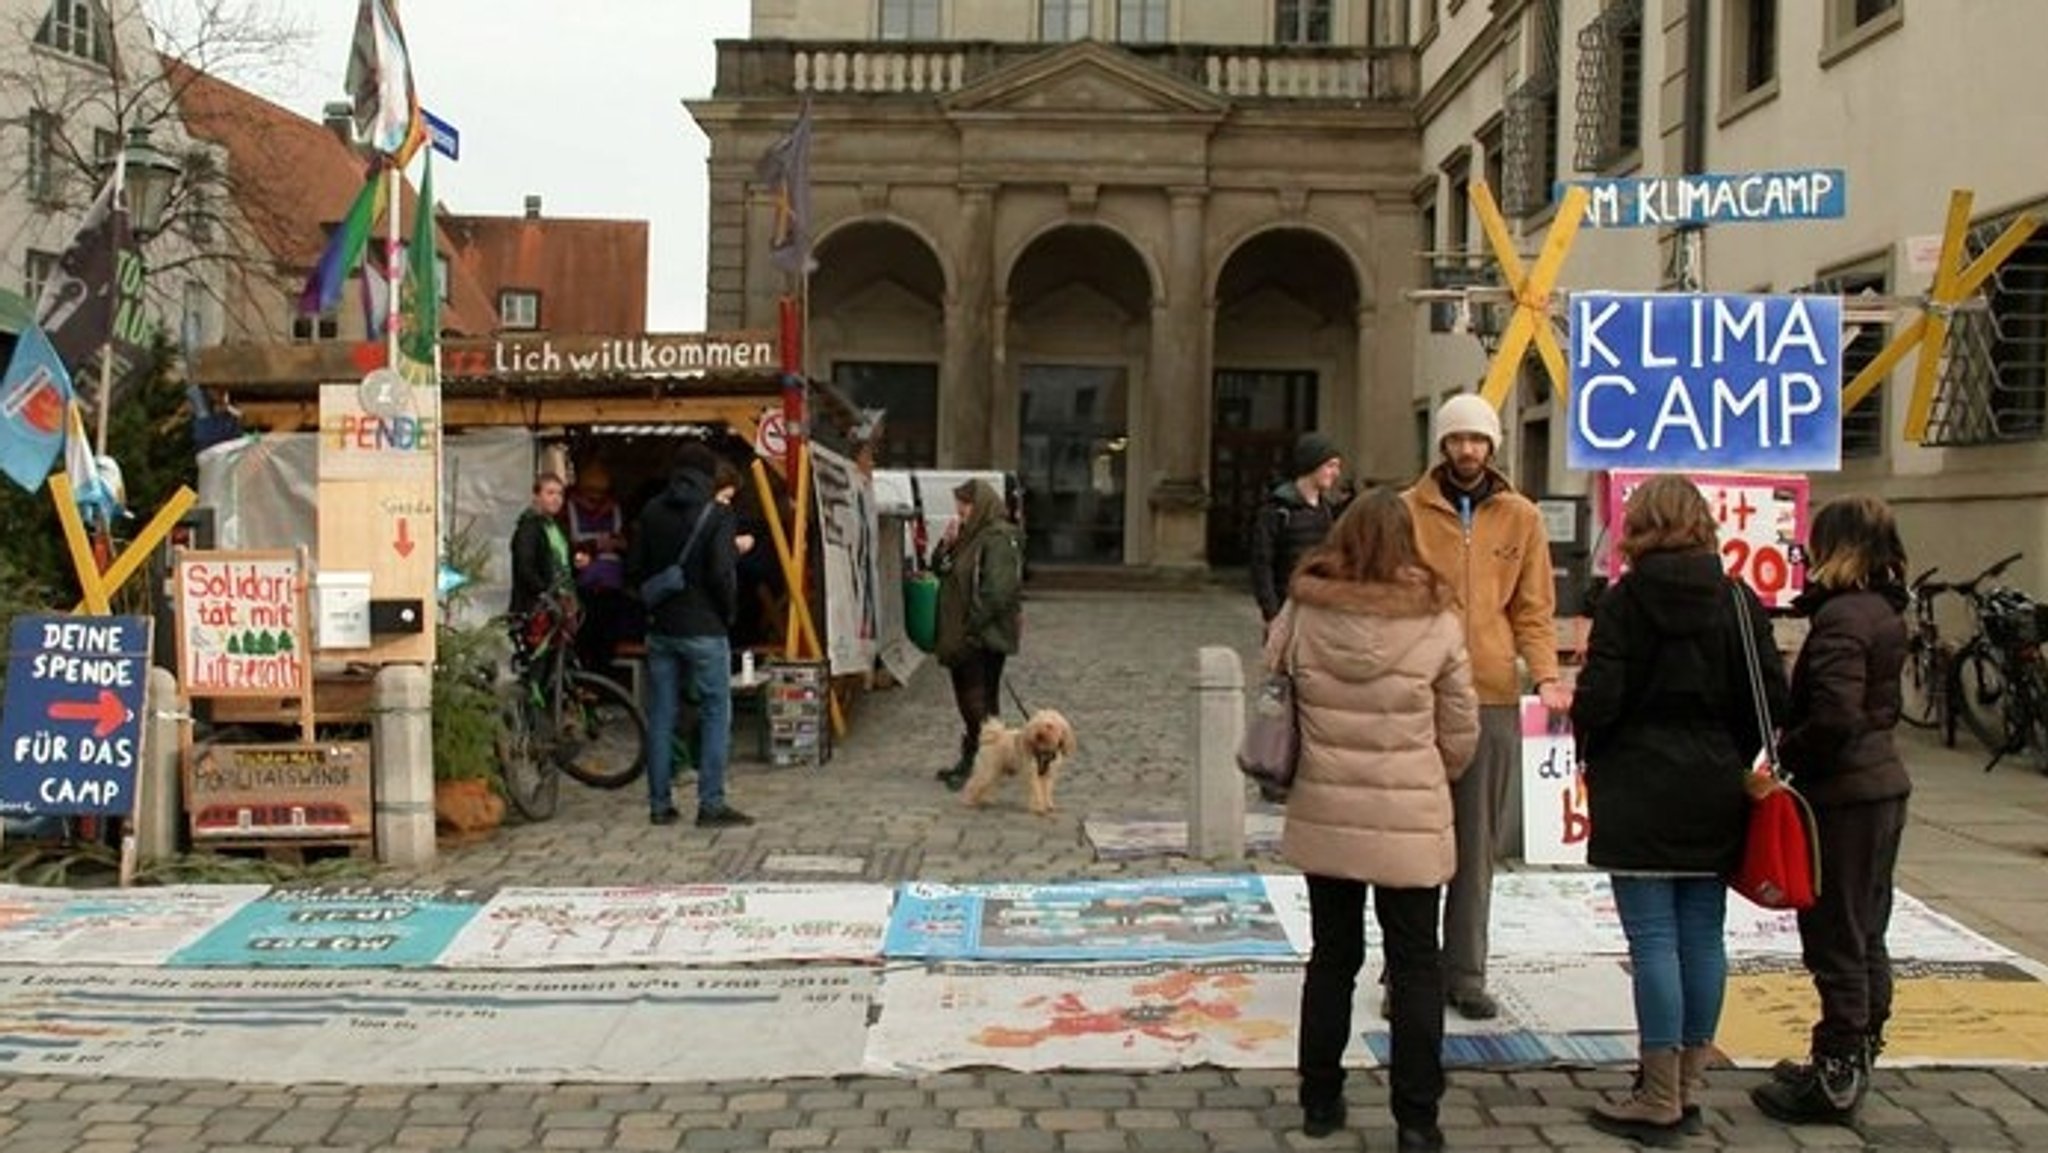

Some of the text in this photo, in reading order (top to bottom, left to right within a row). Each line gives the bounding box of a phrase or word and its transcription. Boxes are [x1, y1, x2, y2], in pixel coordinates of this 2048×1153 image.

[1638, 173, 1833, 224] KLIMACAMP
[1579, 299, 1827, 368] KLIMA
[569, 339, 771, 371] willkommen
[1579, 373, 1822, 452] CAMP
[250, 603, 293, 628] mit
[43, 623, 123, 653] DEINE
[32, 654, 133, 686] SPENDE
[14, 731, 132, 768] FÜR DAS
[40, 778, 120, 806] CAMP
